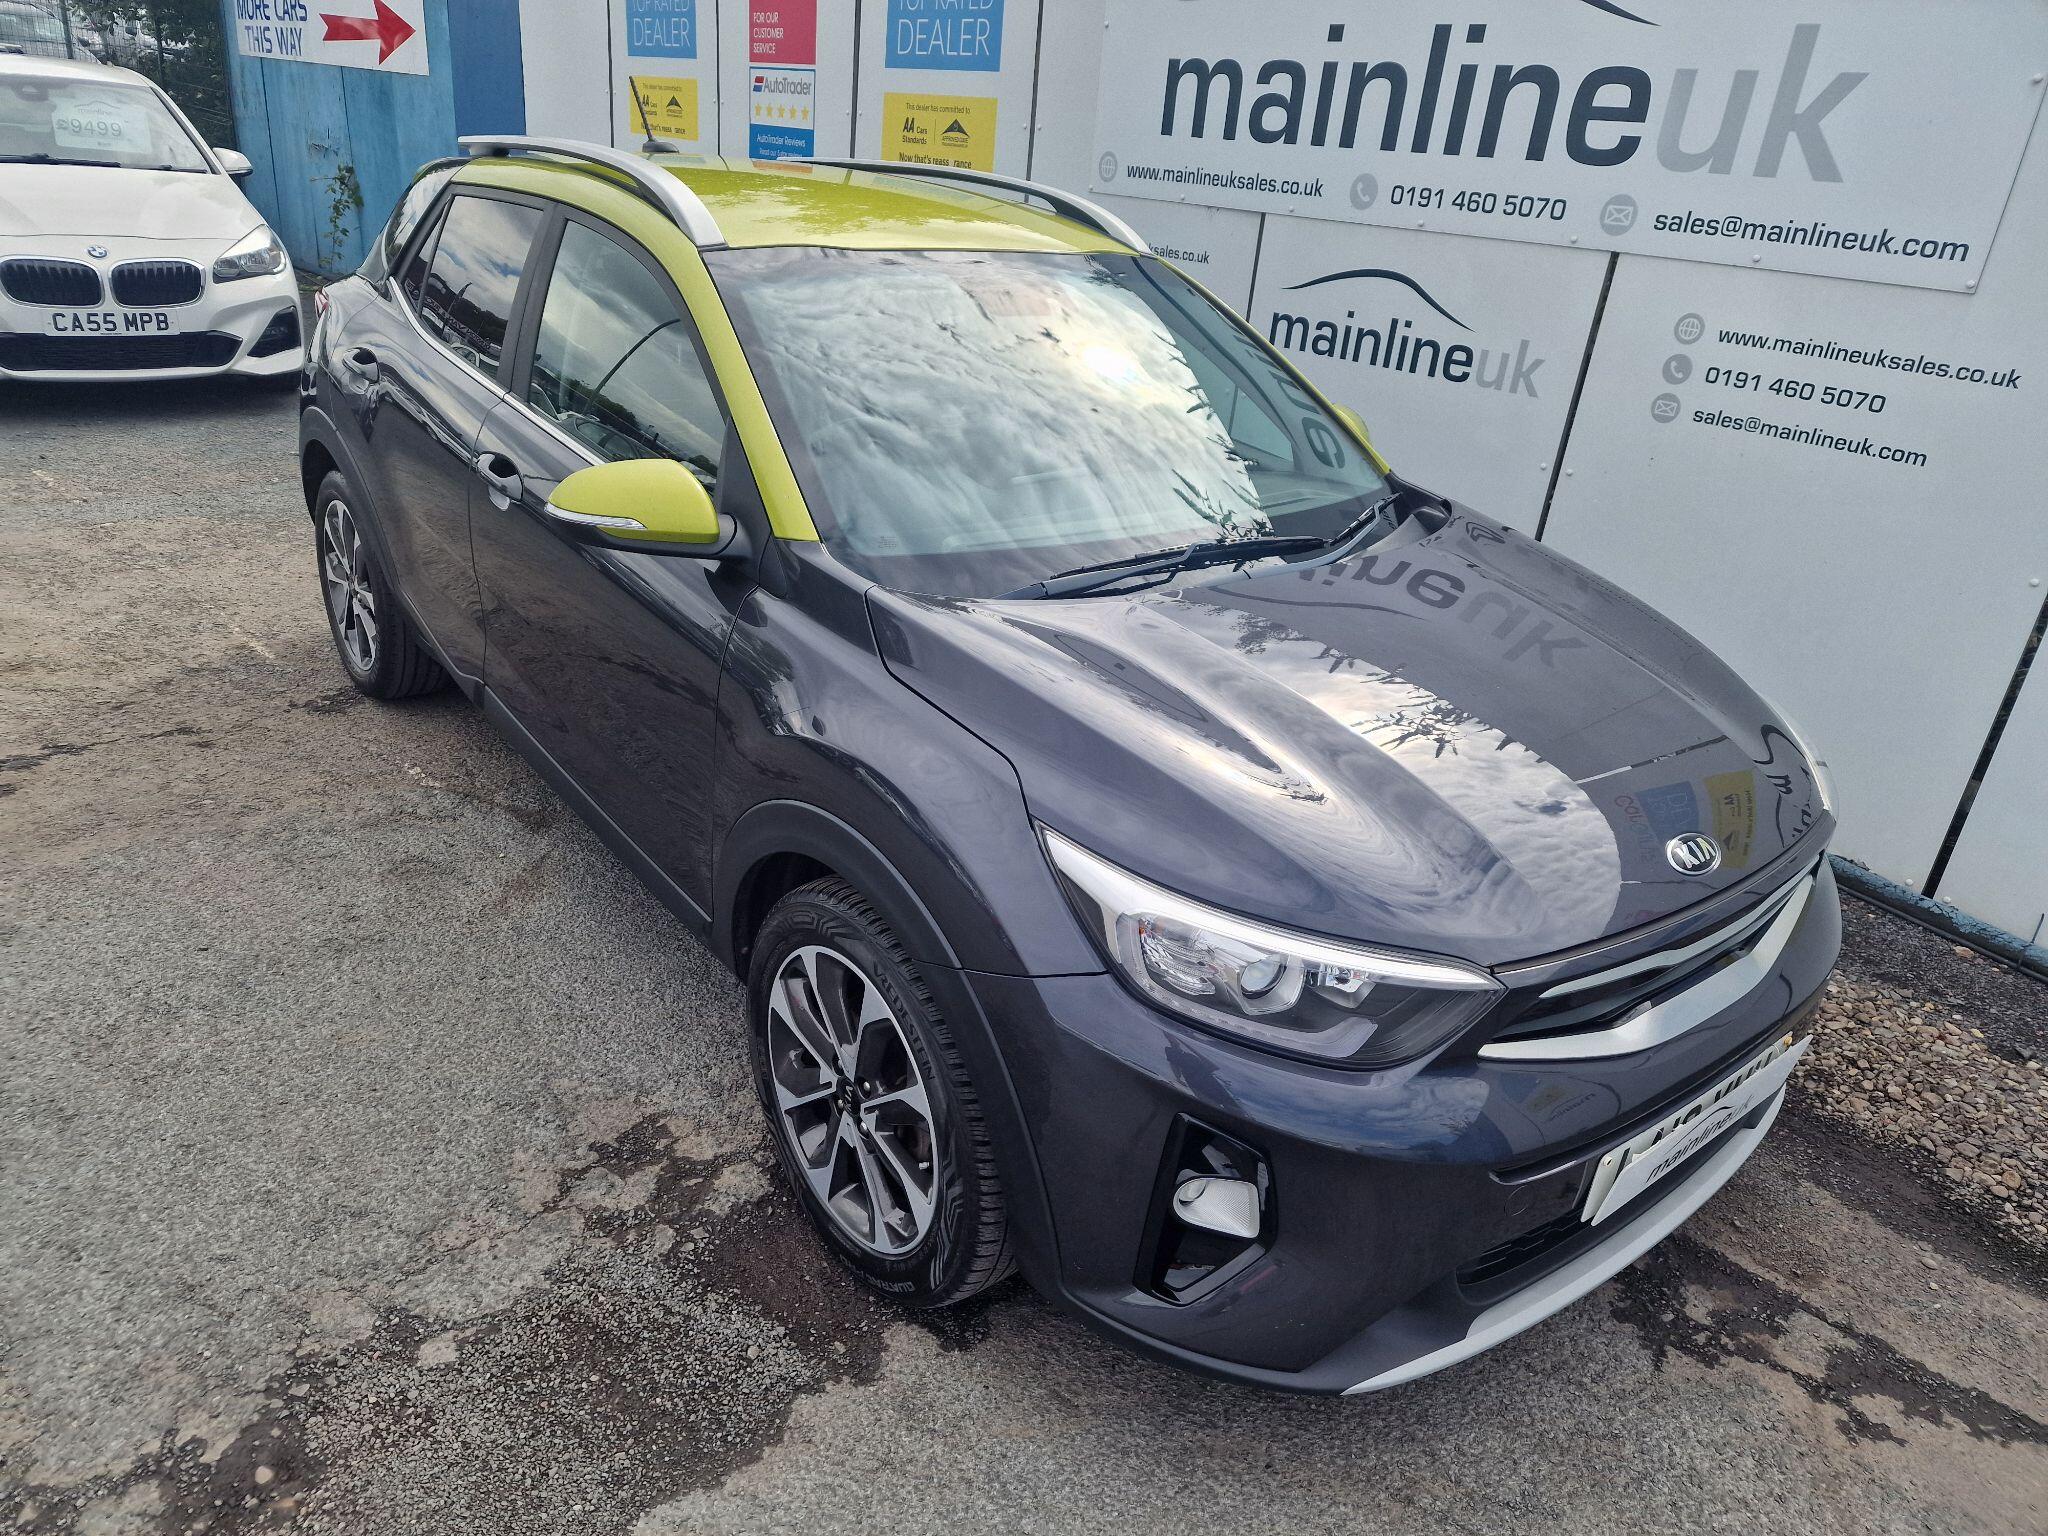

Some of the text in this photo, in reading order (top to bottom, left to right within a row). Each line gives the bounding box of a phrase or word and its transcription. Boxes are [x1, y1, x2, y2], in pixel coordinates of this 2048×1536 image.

[236, 0, 308, 22] MORE CARS
[753, 12, 779, 24] FOR OUR
[244, 25, 303, 57] THIS WAY
[633, 18, 691, 48] DEALER
[753, 27, 784, 39] CUSTOMER
[753, 42, 776, 54] SERVICE
[897, 18, 990, 56] DEALER
[763, 76, 812, 96] AutoTrader
[1160, 23, 1871, 184] mainlineuk
[902, 117, 928, 135] AA Cars
[902, 135, 928, 145] Standards
[1127, 163, 1325, 198] www.mainlineuksales.co.uk
[1390, 184, 1567, 221] 0191 460 5070
[1653, 210, 1970, 262] sales@mainlineuk.com
[51, 312, 170, 332] CA55 MPB
[1267, 310, 1546, 399] mainlineuk
[1718, 328, 2023, 390] www.mainlineuksales.co.uk
[1704, 366, 1887, 414] 0191 460 5070
[1692, 408, 1928, 468] sales@mainlineuk.com
[1673, 837, 1716, 869] KIA
